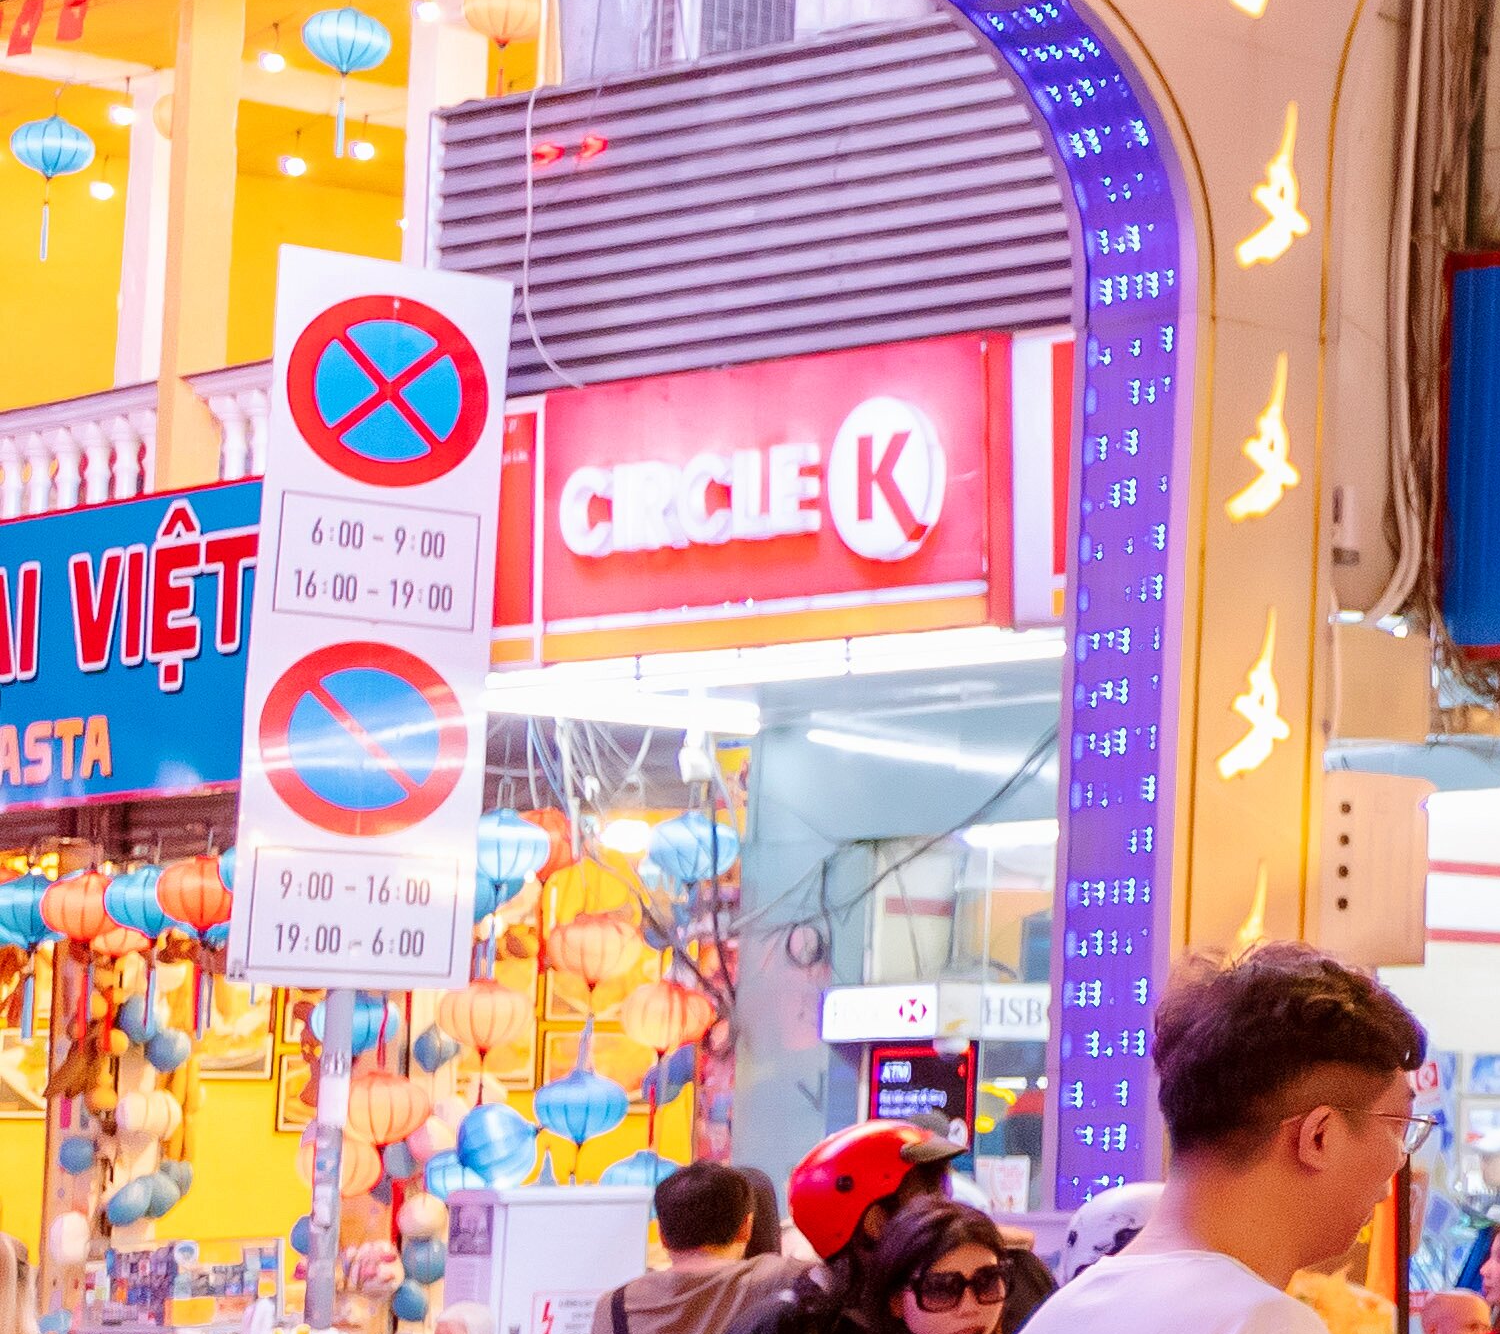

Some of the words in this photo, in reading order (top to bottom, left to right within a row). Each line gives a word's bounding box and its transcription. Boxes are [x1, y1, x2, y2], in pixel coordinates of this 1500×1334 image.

[559, 442, 822, 559] CIRCLE
[310, 516, 364, 551] 6:00
[393, 526, 446, 560] 9:00
[68, 497, 261, 693] VIỆT
[293, 568, 358, 603] 16:00
[389, 578, 453, 613] 19:00
[279, 869, 334, 902] 9:00
[366, 875, 431, 908] 16:00
[274, 922, 342, 955] 19:00
[371, 927, 425, 958] 6:00
[984, 996, 1049, 1028] HSB
